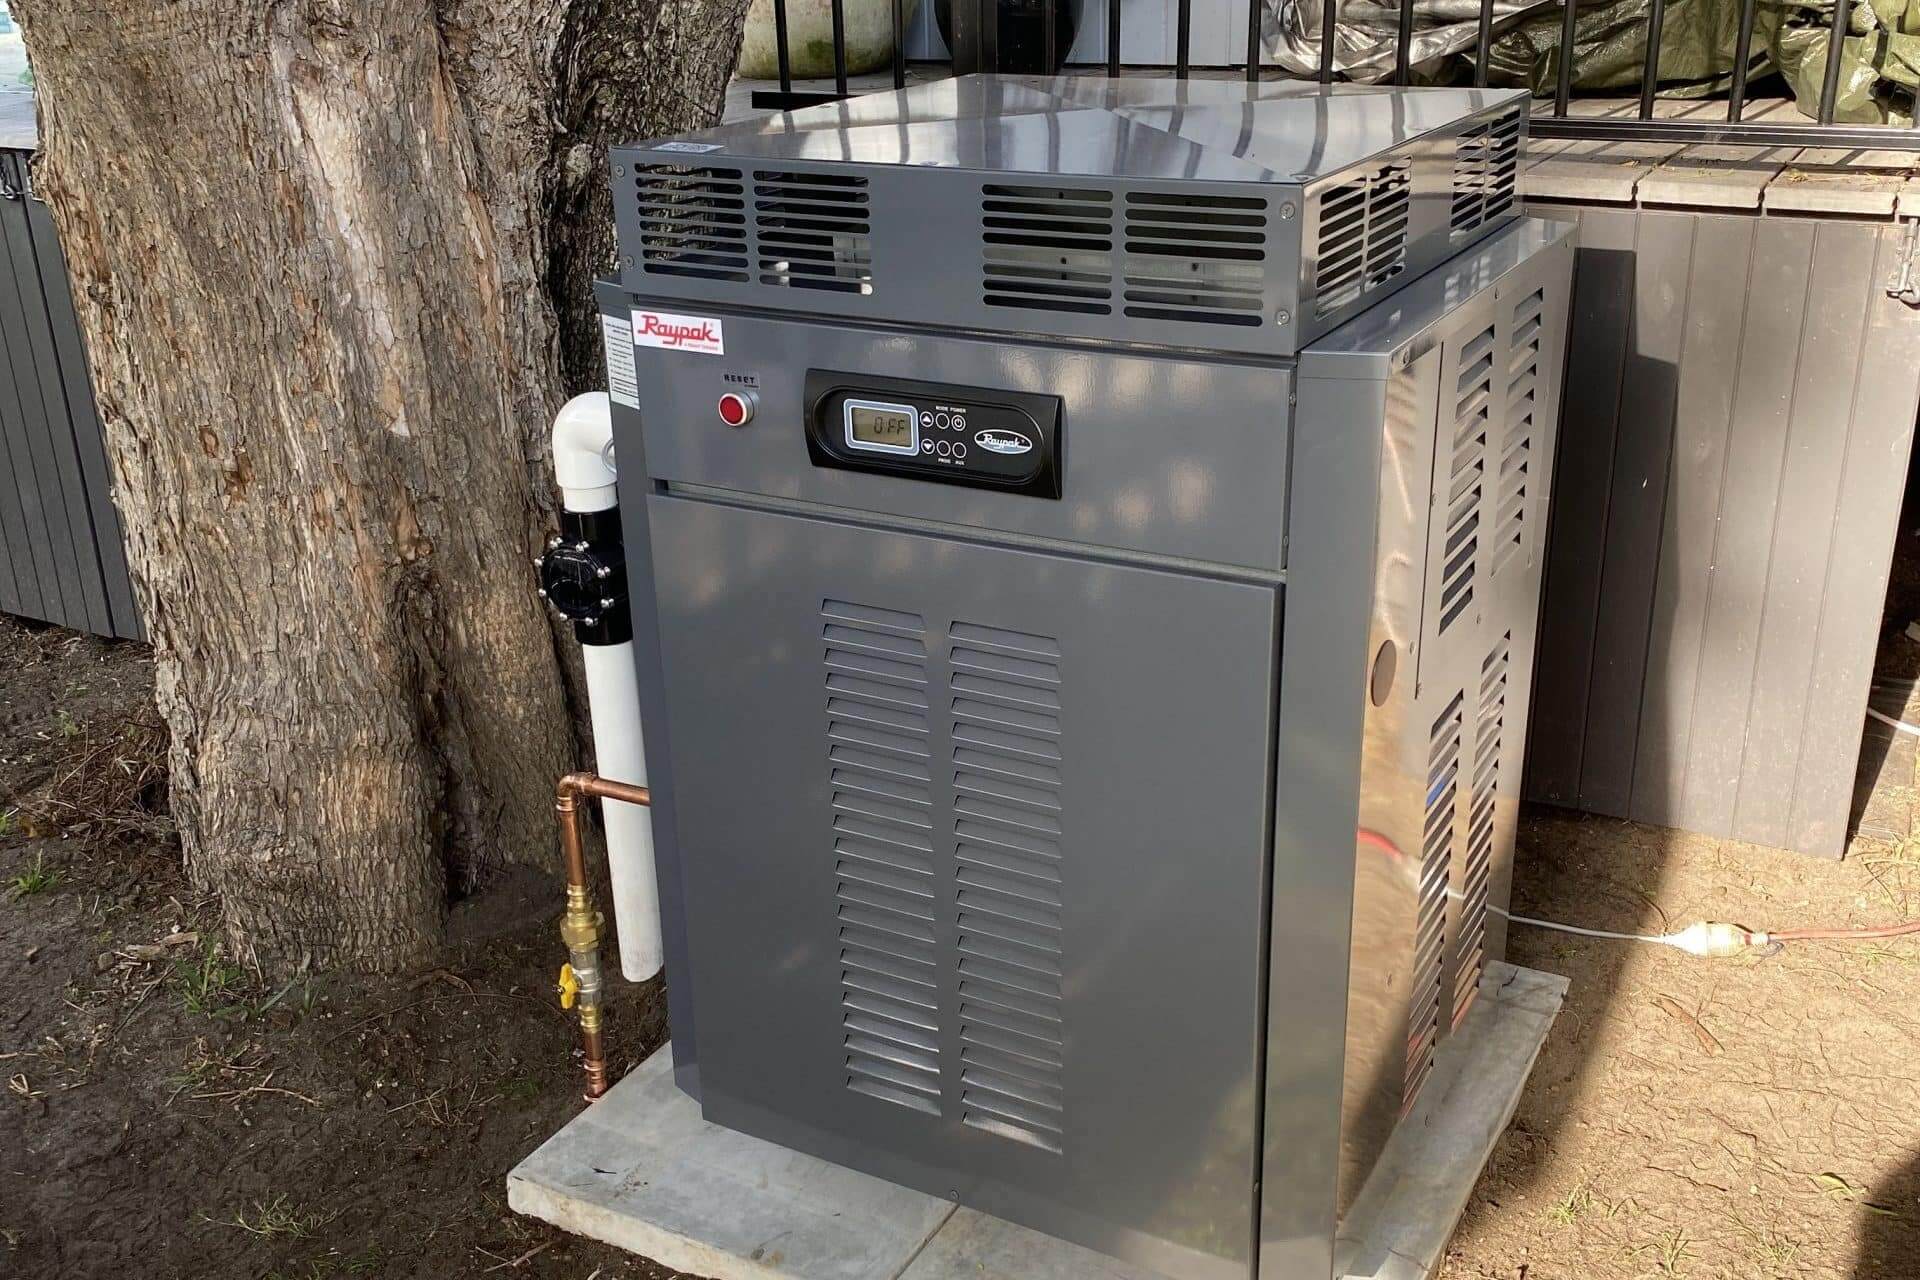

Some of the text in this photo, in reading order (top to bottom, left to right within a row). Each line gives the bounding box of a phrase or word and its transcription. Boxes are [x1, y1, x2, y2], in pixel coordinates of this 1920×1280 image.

[638, 314, 719, 346] Raypak
[724, 374, 754, 384] RESET
[874, 416, 904, 434] OFF
[977, 433, 1030, 449] Raypak
